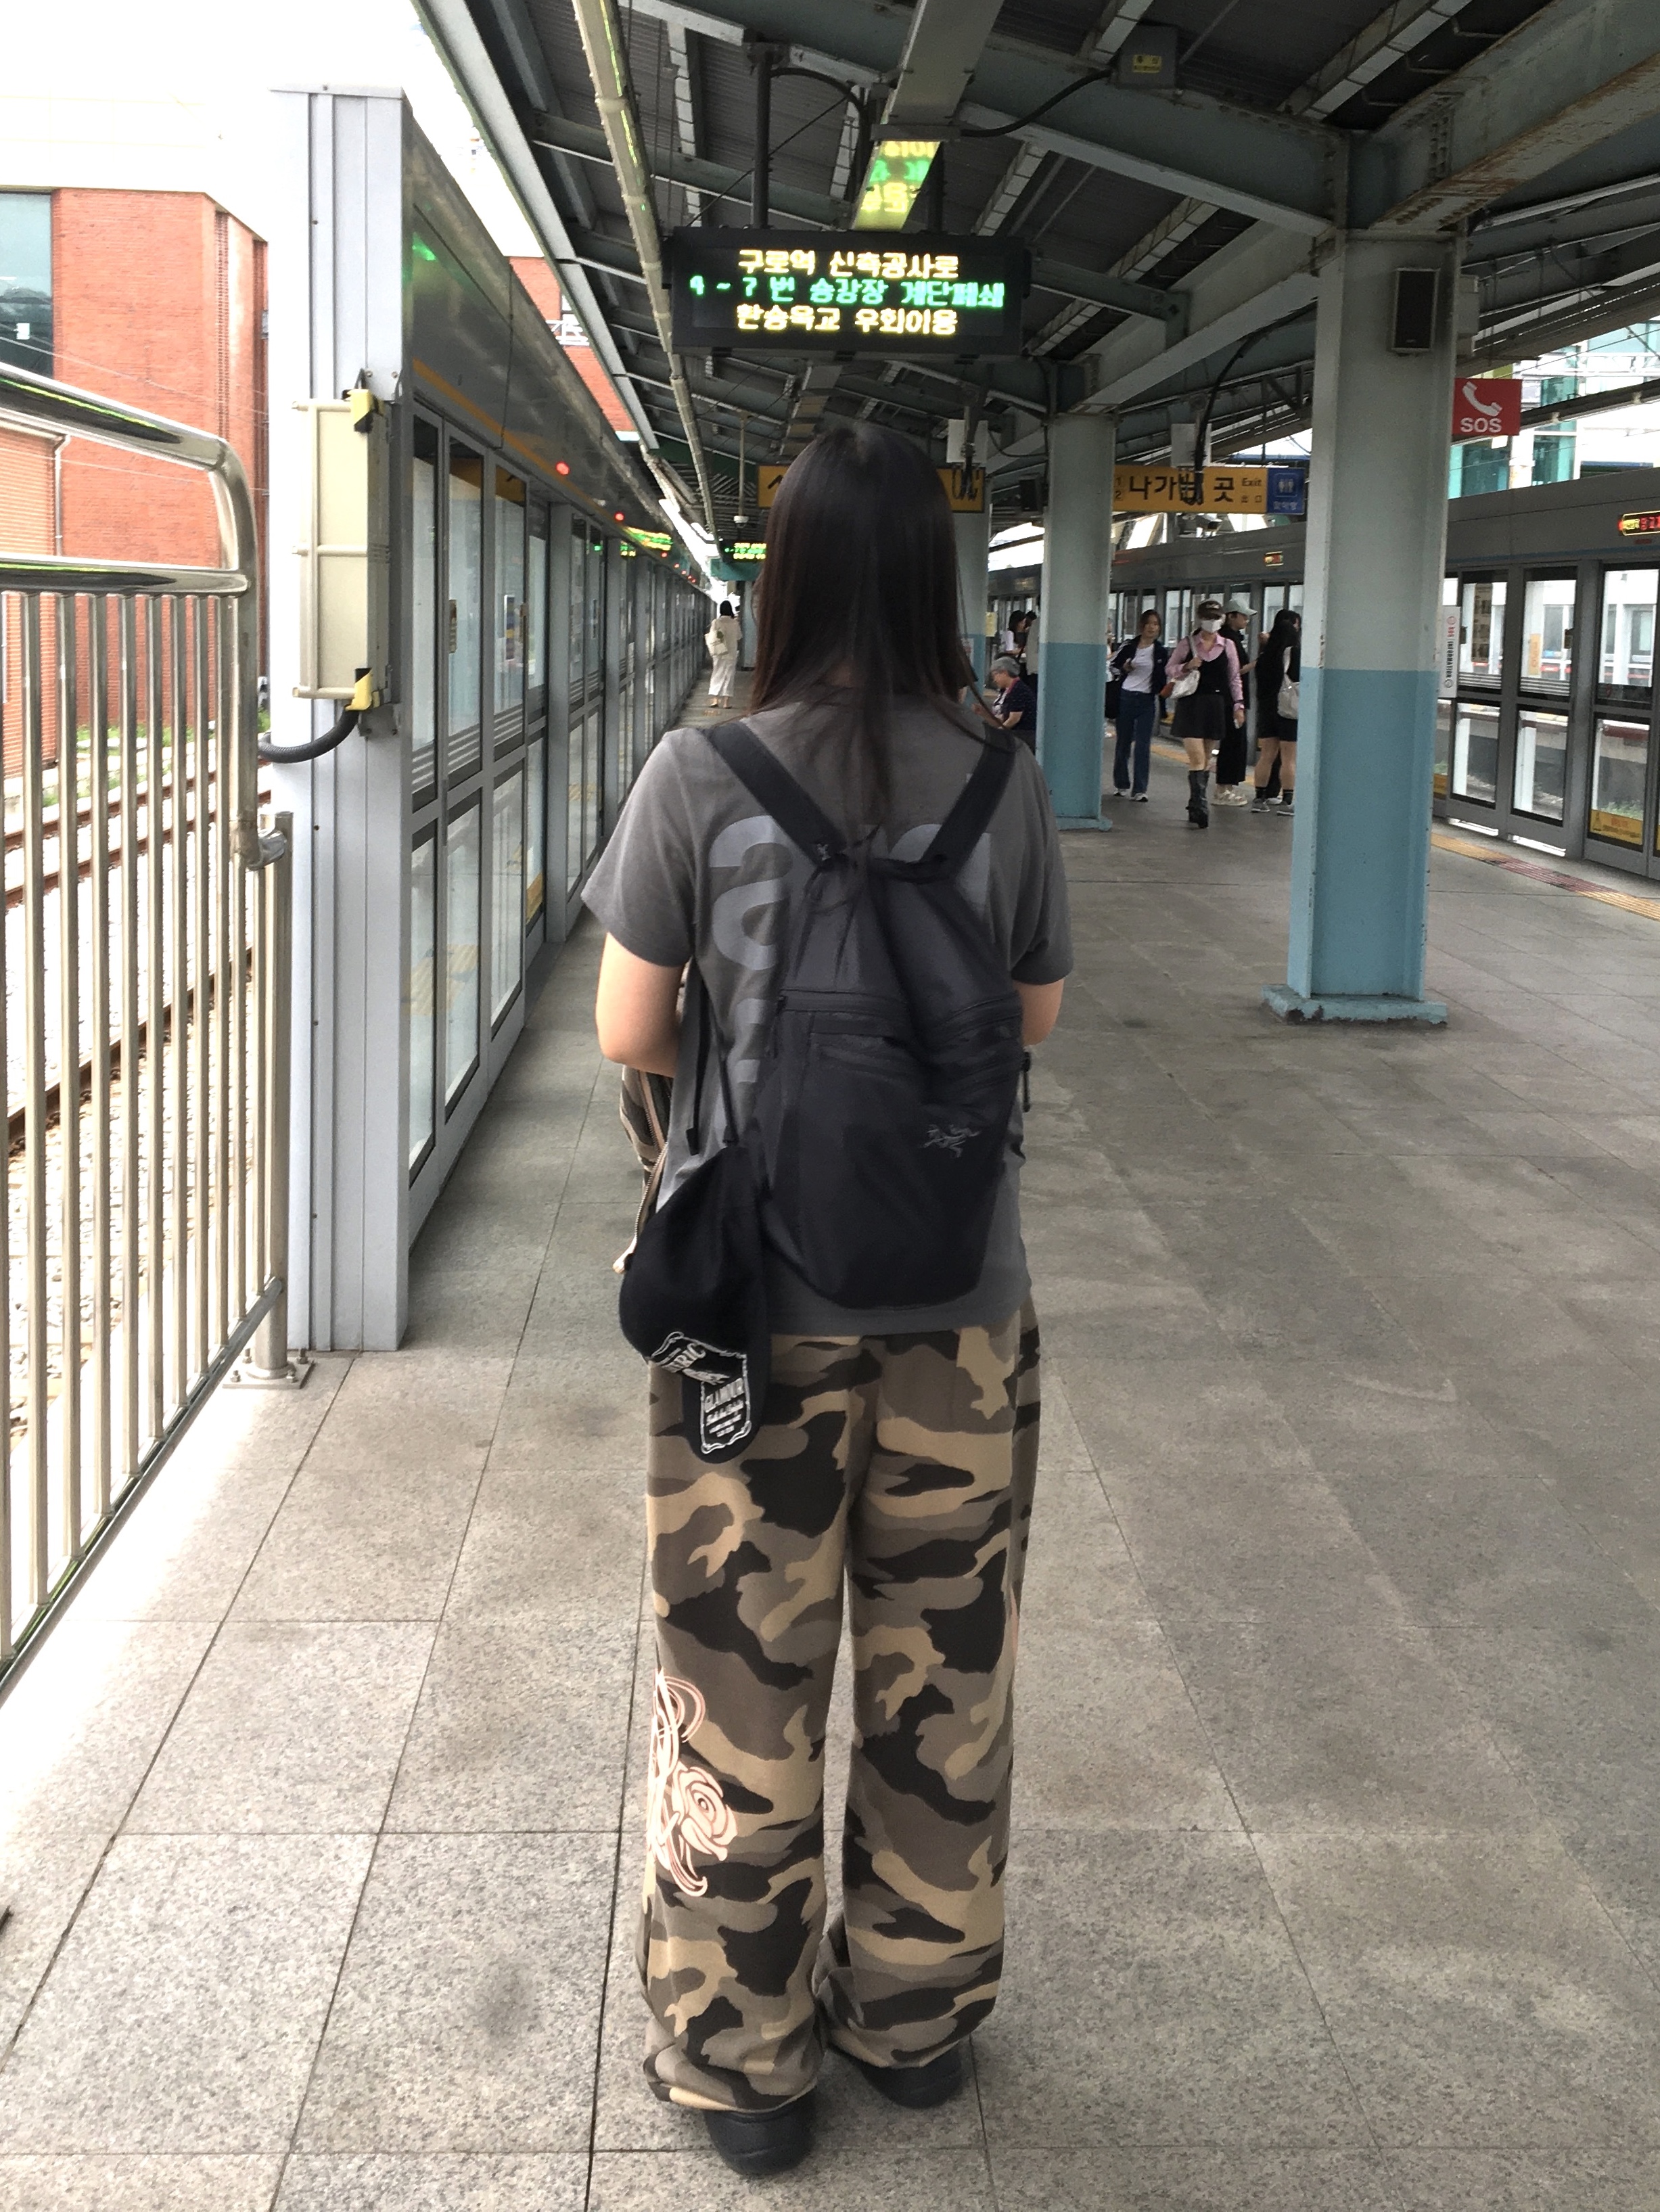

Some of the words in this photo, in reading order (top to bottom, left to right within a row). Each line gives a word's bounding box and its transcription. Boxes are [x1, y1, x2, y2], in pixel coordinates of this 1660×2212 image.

[738, 249, 816, 275] 구로역
[829, 251, 959, 279] 신축공사로
[742, 276, 757, 296] 7
[770, 276, 796, 302] 번
[810, 277, 889, 304] 승강장
[900, 280, 1005, 308] 계단폐쇄
[737, 303, 841, 331] 환승육교
[854, 308, 959, 335] 우회이용
[1460, 417, 1502, 433] SOS
[1214, 476, 1235, 503] 곳
[1241, 477, 1262, 487] Exit
[1446, 641, 1454, 678] INFORMATION
